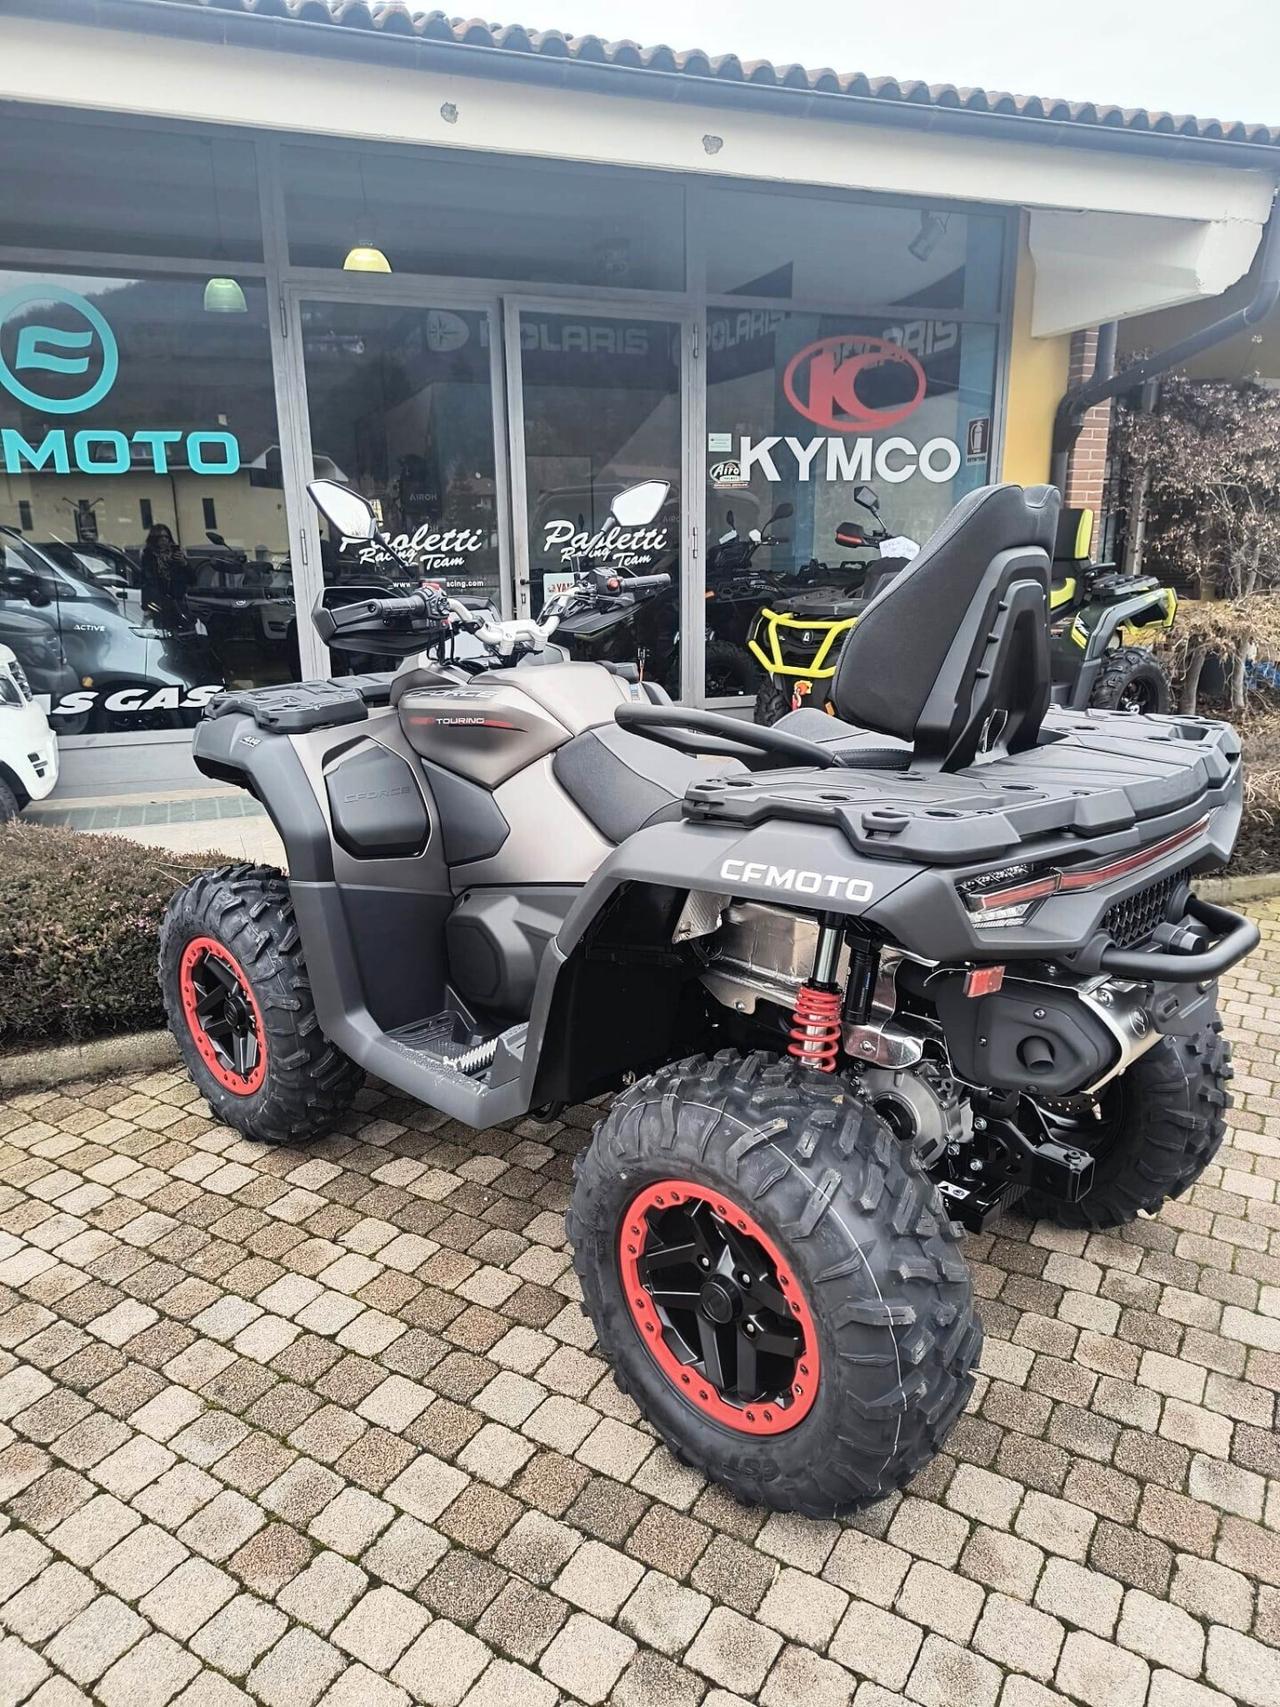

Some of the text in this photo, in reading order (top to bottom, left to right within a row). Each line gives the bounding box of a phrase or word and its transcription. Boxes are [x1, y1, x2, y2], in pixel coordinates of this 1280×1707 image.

[740, 437, 961, 483] KYMCO
[713, 463, 741, 477] Airo
[419, 553, 465, 570] Team
[612, 552, 652, 567] Team
[73, 624, 106, 632] ACTIVE
[104, 685, 224, 712] GAS
[435, 717, 486, 725] TOURING
[720, 859, 874, 902] CFMOTO
